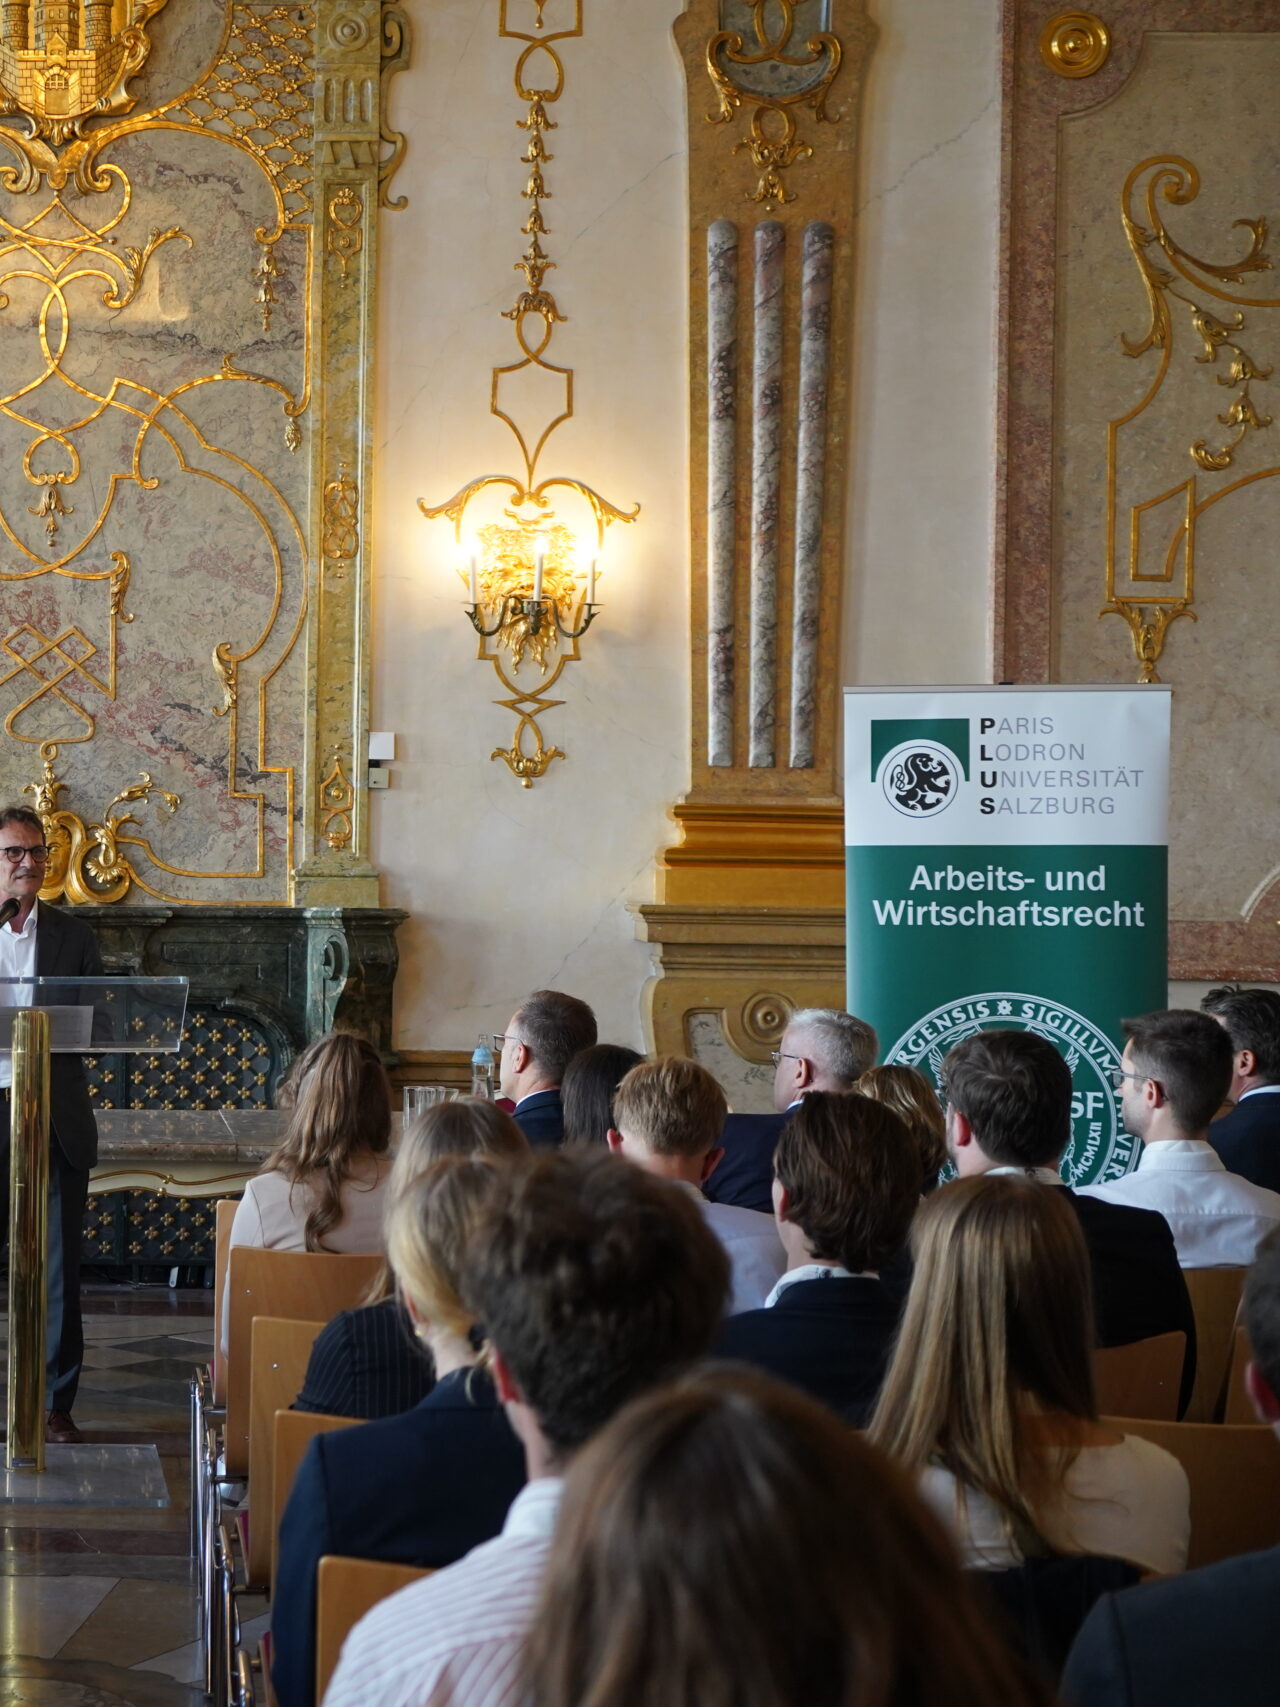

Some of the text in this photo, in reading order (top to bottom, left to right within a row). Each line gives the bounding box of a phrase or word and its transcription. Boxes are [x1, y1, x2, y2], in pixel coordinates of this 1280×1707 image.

[980, 717, 1054, 734] PARIS
[980, 743, 1085, 761] LODRON
[980, 767, 1144, 788] UNIVERSITÄT
[980, 797, 1115, 815] SALZBURG
[909, 865, 1106, 892] Arbeits- und
[872, 900, 1145, 927] Wirtschaftsrecht
[891, 1001, 991, 1066] RGENSIS
[1074, 1122, 1102, 1178] MCMLXII
